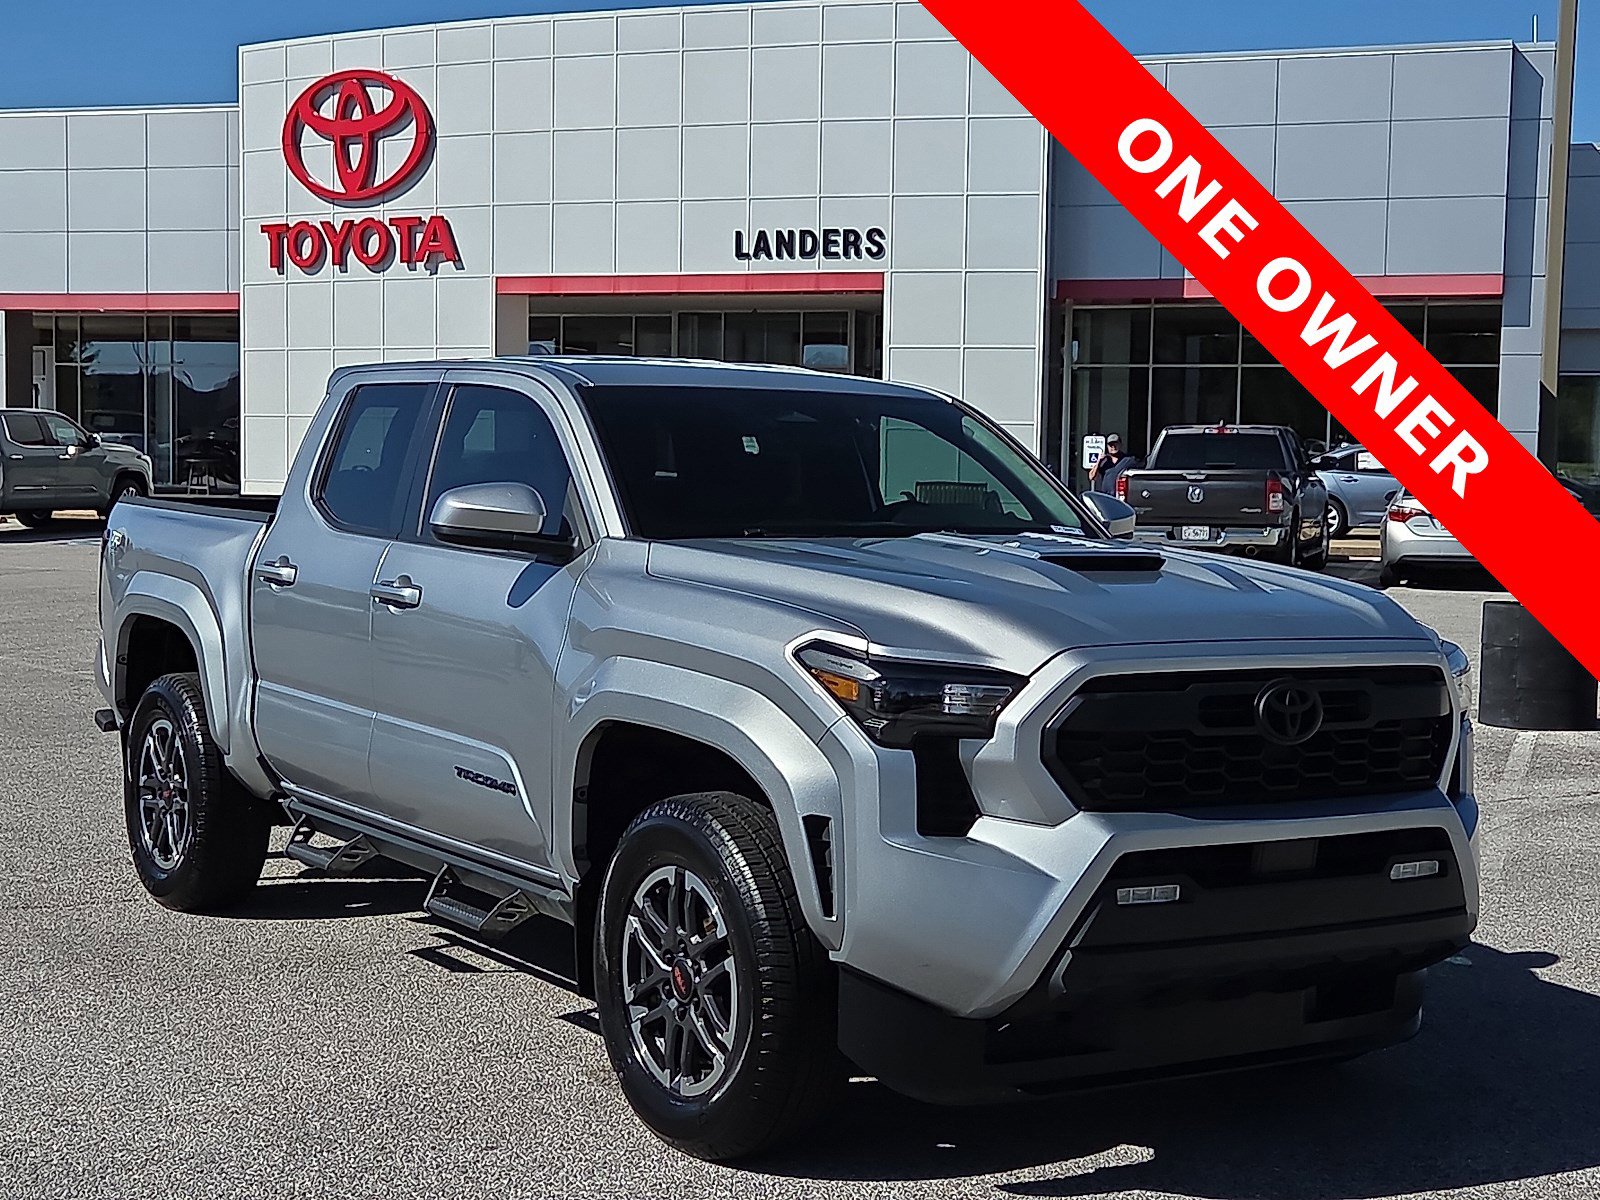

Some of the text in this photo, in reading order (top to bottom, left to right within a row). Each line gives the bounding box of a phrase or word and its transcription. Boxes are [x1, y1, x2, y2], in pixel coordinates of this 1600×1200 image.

[261, 215, 460, 271] TOYOTA
[735, 228, 886, 260] LANDERS
[454, 765, 517, 797] TACOMA
